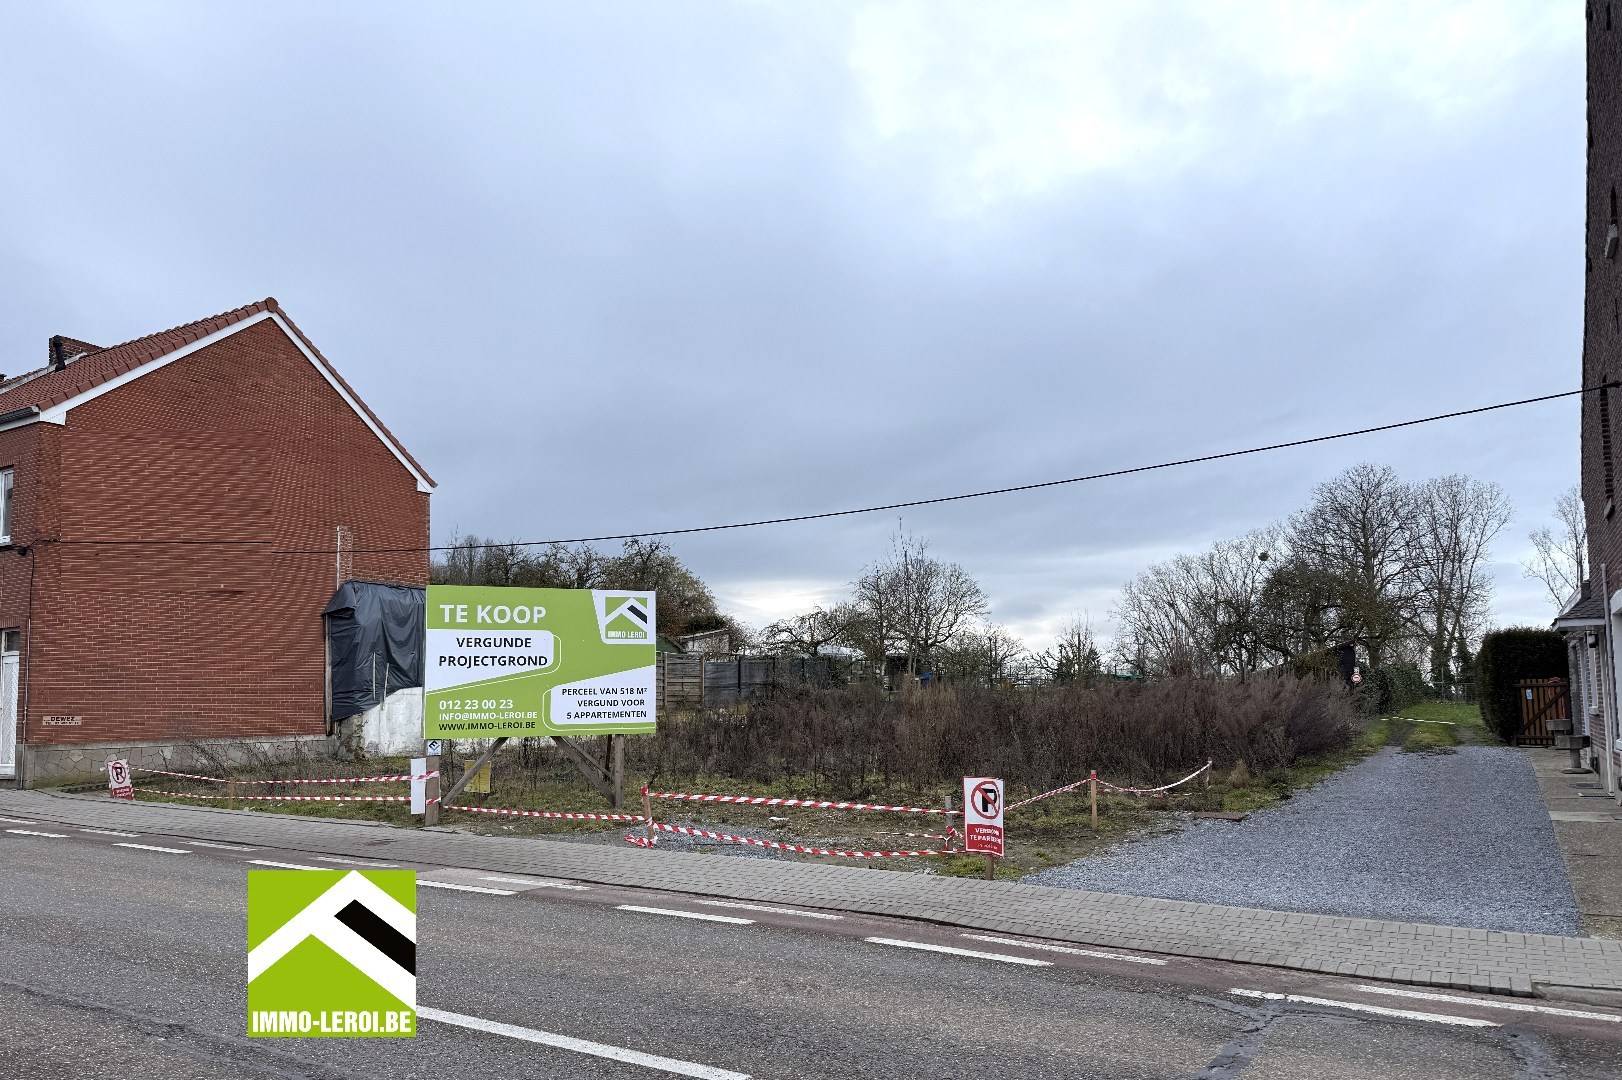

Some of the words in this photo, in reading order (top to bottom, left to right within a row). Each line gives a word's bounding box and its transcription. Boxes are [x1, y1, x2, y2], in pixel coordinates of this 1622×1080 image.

[440, 604, 468, 623] TE
[477, 604, 546, 624] KOOP
[607, 630, 626, 638] IMMO
[627, 630, 645, 639] LEROI
[456, 637, 532, 648] VERGUNDE
[439, 655, 548, 669] PROJECTGROND
[562, 688, 597, 696] PERCEEL
[599, 687, 618, 695] VAN
[620, 687, 635, 695] 518
[439, 700, 461, 710] 012
[464, 700, 479, 710] 23
[482, 699, 496, 709] 00
[499, 699, 514, 709] 23
[577, 699, 619, 707] VERGUND
[620, 699, 645, 707] VOOR
[439, 711, 537, 721] INFO@IMMO-LEROI.BE
[566, 711, 572, 720] 5
[573, 710, 647, 719] APPARTEMENTEN
[439, 722, 536, 731] WWW.IMMO-LEROI.BE
